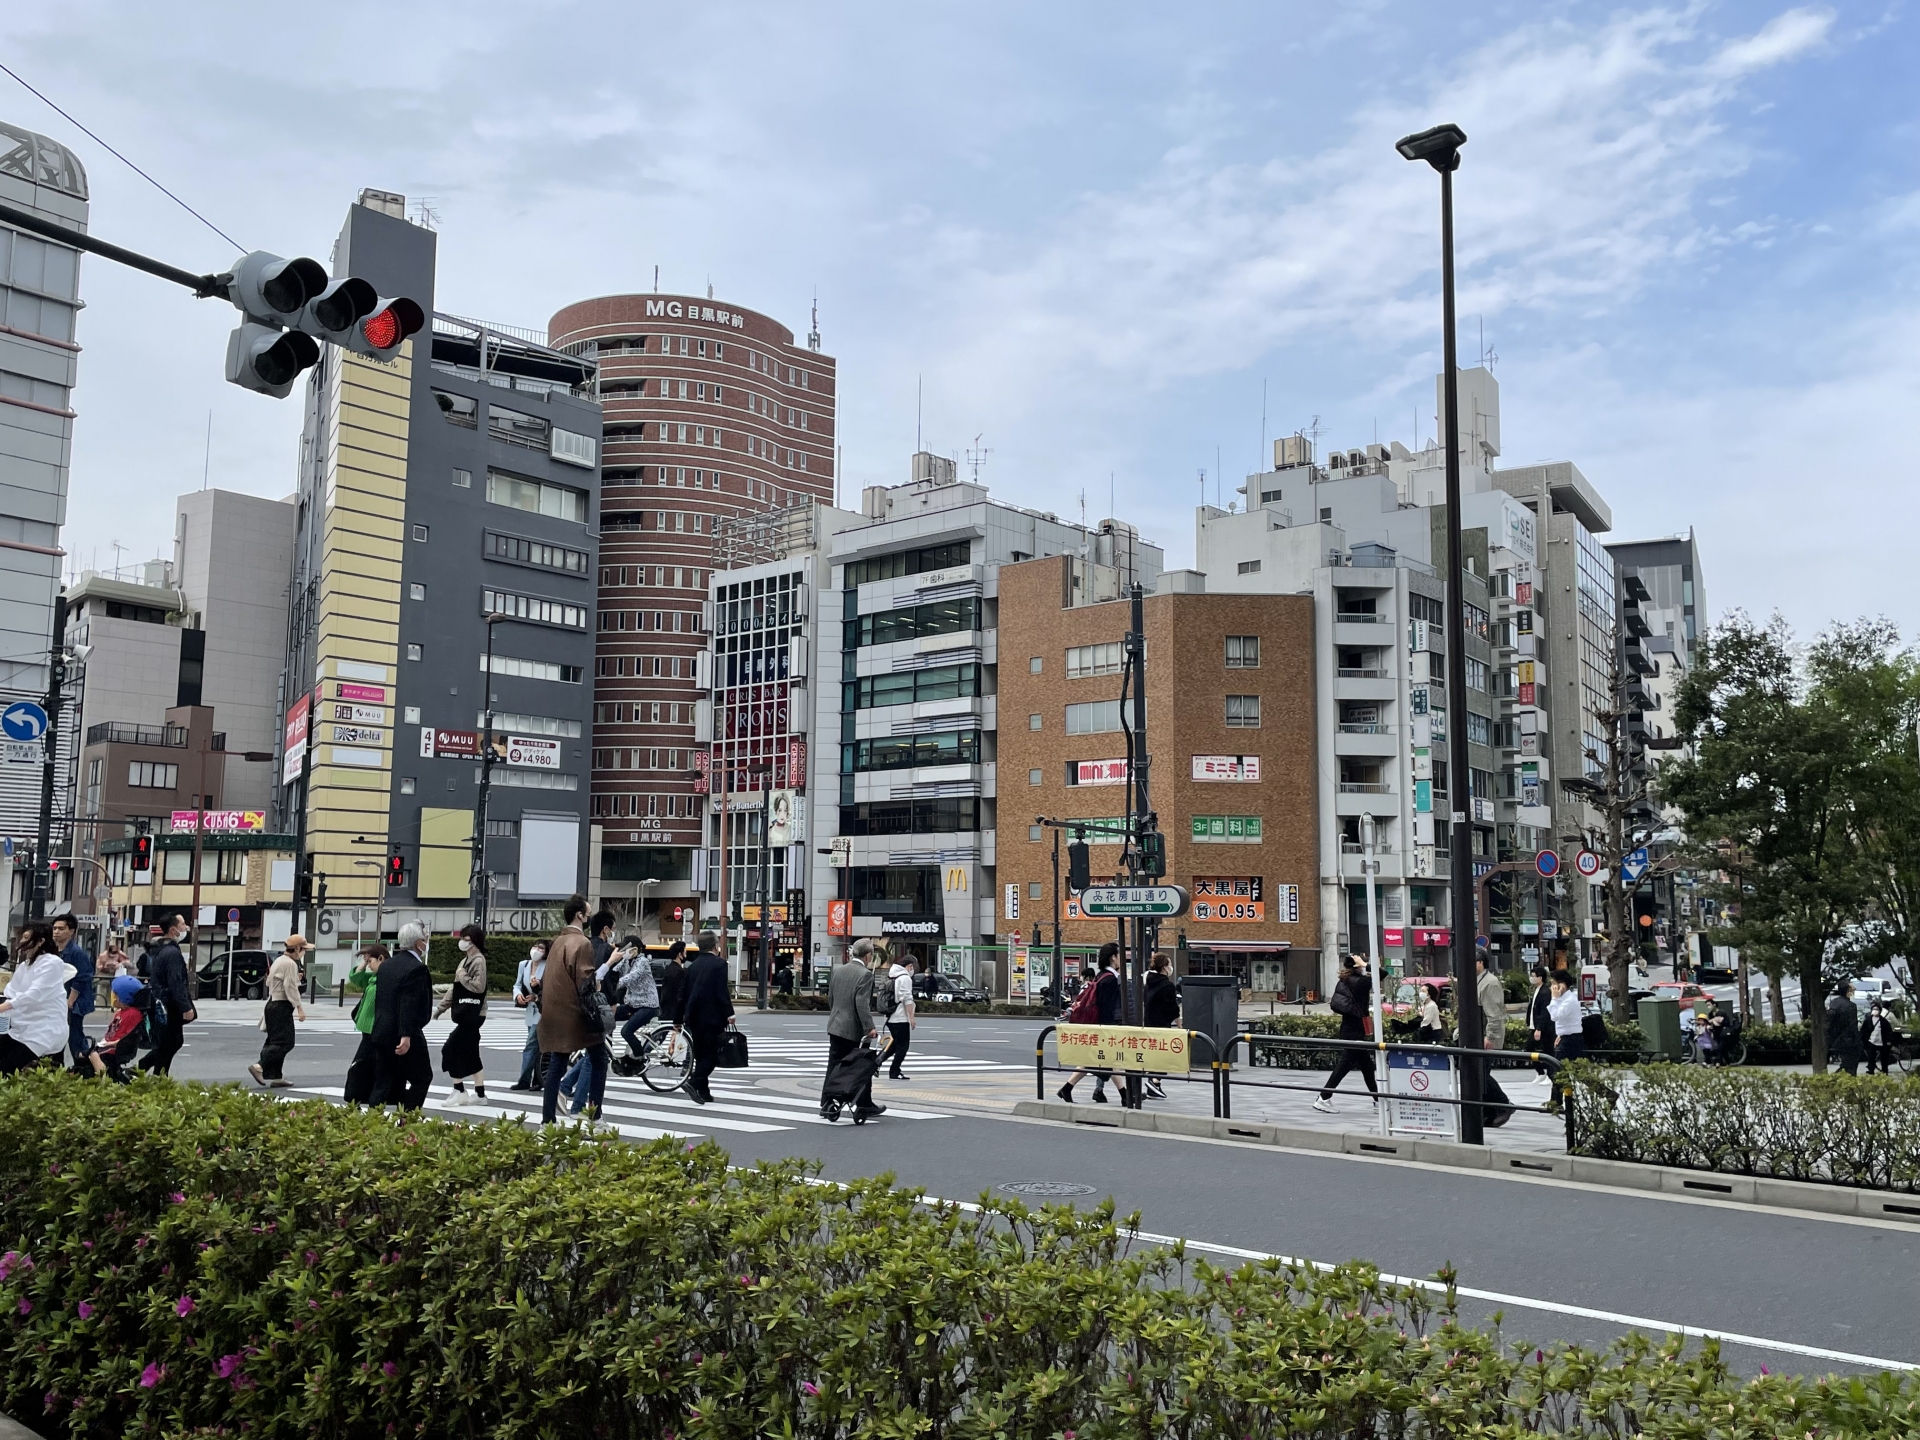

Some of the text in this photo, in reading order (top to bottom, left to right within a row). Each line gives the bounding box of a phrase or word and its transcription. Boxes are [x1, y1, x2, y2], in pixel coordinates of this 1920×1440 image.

[646, 300, 744, 328] MG 目黒駅前
[739, 707, 787, 728] ROYS
[451, 735, 473, 745] MUU
[1080, 765, 1103, 780] mini
[640, 820, 661, 829] MG
[1193, 820, 1242, 834] 3F 歯科
[630, 832, 672, 844] 目黒駅前
[1582, 857, 1595, 868] 40
[1196, 880, 1250, 896] 大黒屋
[1106, 890, 1168, 902] 花房山通り
[1103, 904, 1143, 913] Hanabusayama
[509, 910, 549, 931] CUBA
[882, 922, 939, 933] McDonald's
[1060, 1033, 1169, 1052] 歩行喫煙・ポイ捨て禁止
[1097, 1050, 1145, 1063] 品川区
